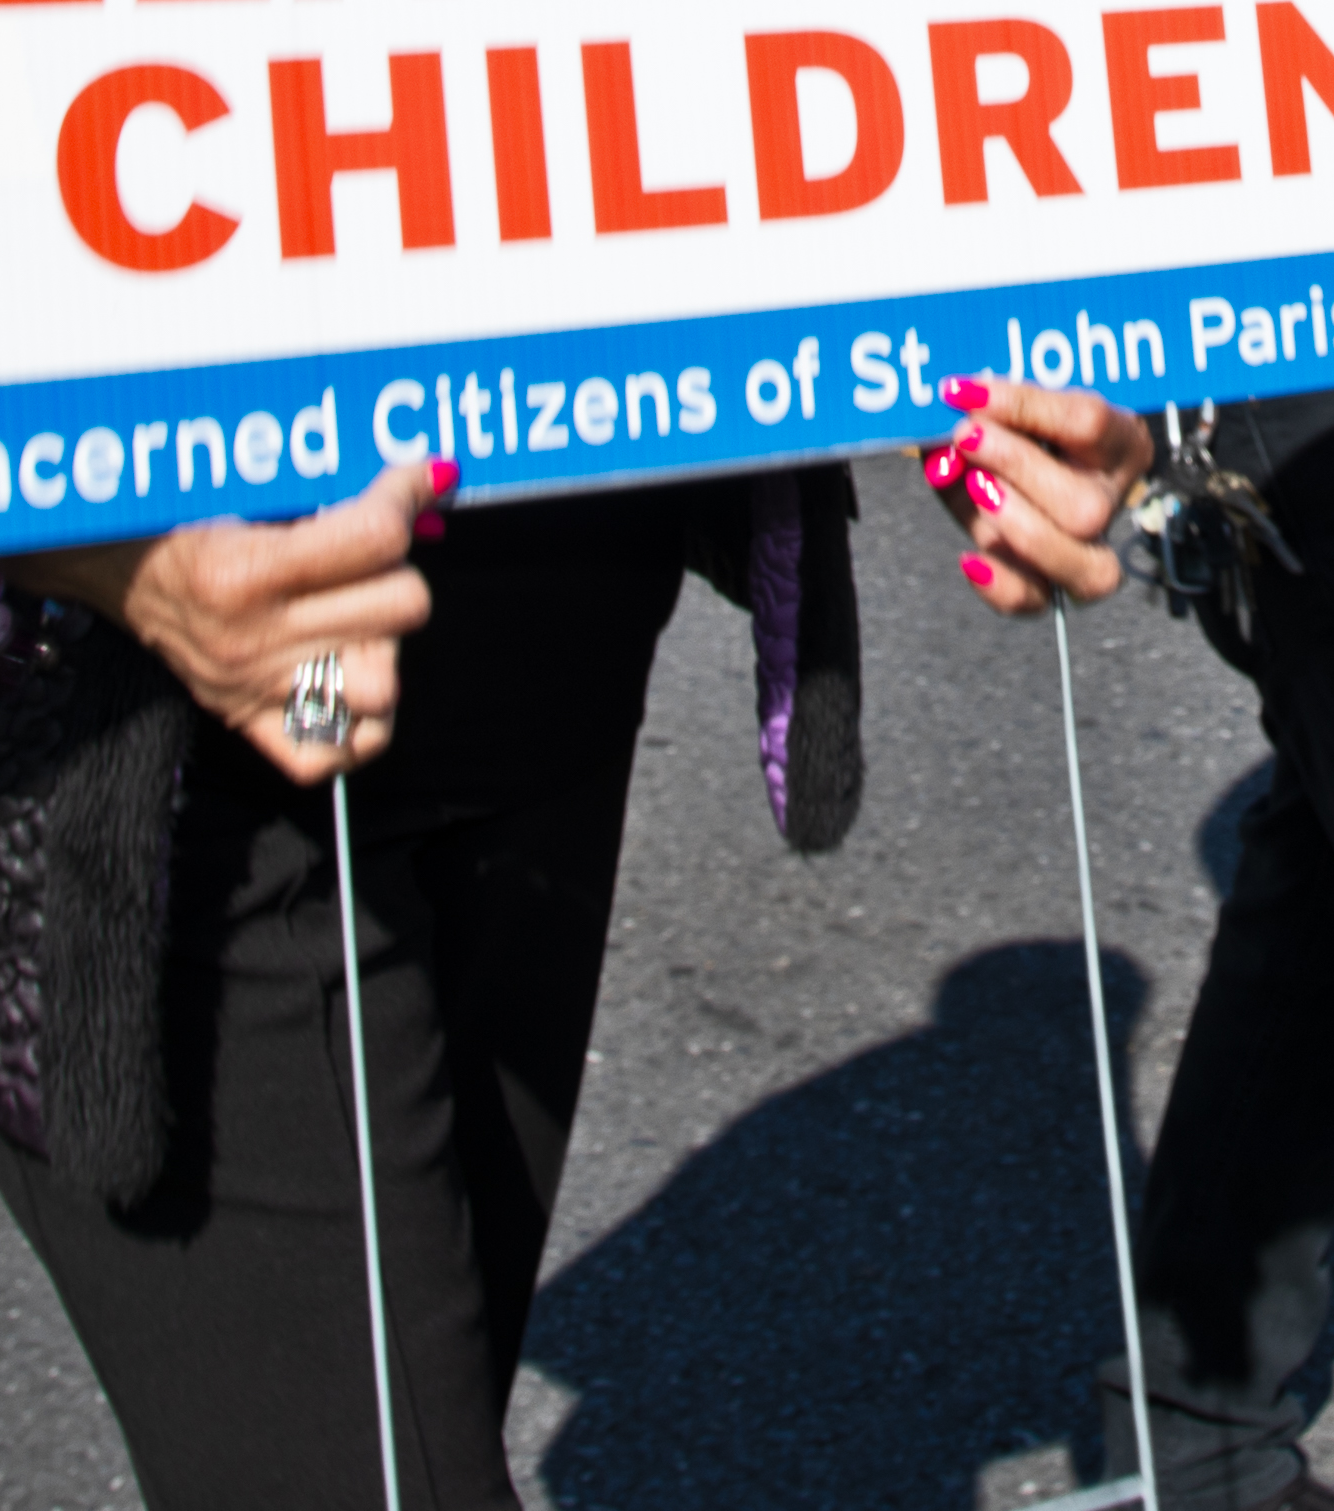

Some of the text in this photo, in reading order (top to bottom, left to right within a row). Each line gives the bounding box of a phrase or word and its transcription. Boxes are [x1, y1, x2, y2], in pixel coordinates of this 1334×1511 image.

[372, 373, 718, 461] Citizens
[745, 337, 820, 425] of
[977, 309, 1166, 392] John
